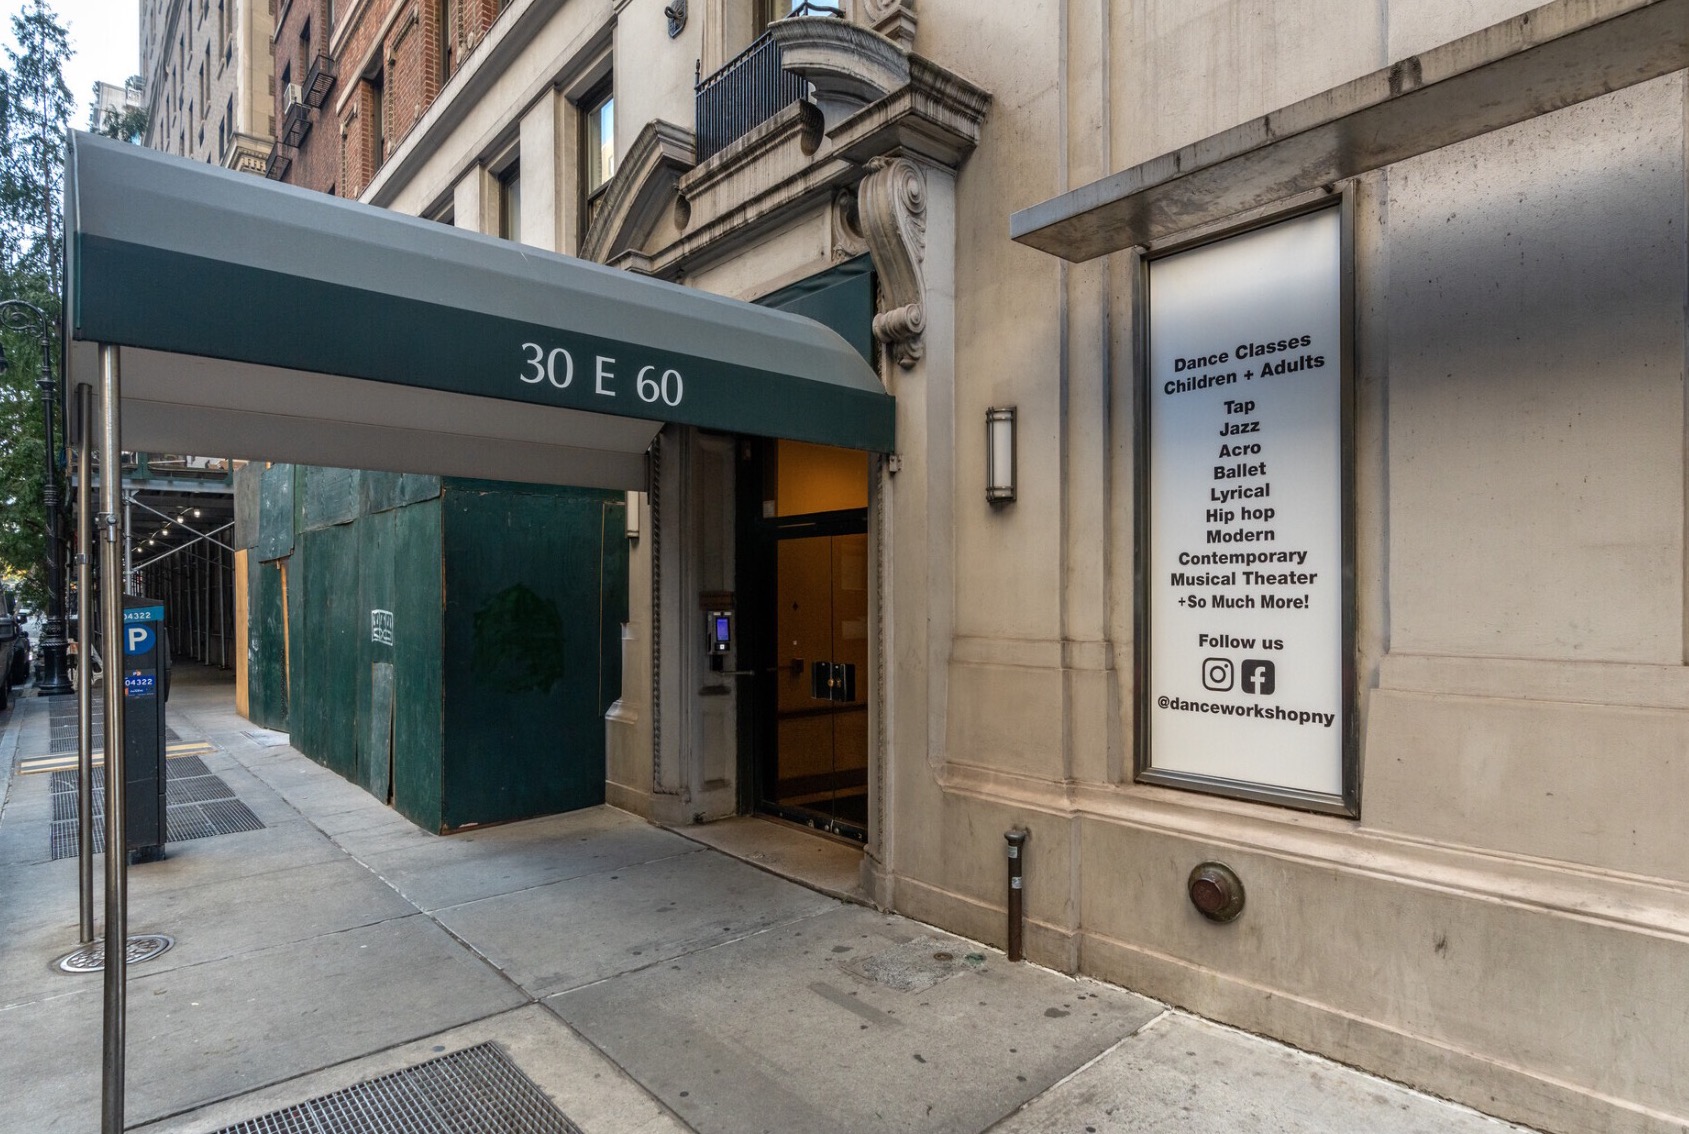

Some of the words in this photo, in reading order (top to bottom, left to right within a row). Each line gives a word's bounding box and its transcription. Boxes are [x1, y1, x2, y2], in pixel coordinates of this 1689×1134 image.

[1174, 352, 1229, 373] Dance
[1235, 334, 1312, 360] Classes
[520, 342, 574, 389] 30
[595, 355, 616, 397] E
[636, 365, 684, 407] 60
[1163, 373, 1237, 396] Children
[1243, 369, 1254, 381] +
[1260, 354, 1325, 379] Adults
[1223, 399, 1256, 416] Tap
[1219, 420, 1261, 437] Jazz
[1218, 442, 1262, 459] Acro
[1213, 461, 1267, 481] Ballet
[1210, 482, 1271, 504] Lyrical
[1206, 507, 1236, 525] Hip
[1240, 506, 1276, 523] hop
[1206, 527, 1276, 544] Modern
[1178, 549, 1308, 567] Contemporary
[1170, 570, 1237, 588] Musical
[1241, 570, 1318, 587] Theater
[1211, 594, 1256, 610] Much
[1260, 593, 1310, 610] More!
[128, 627, 148, 652] P
[1198, 633, 1257, 651] Follow
[1261, 638, 1285, 652] us
[124, 678, 153, 687] 04322
[1157, 695, 1336, 728] @danceworkshopny
